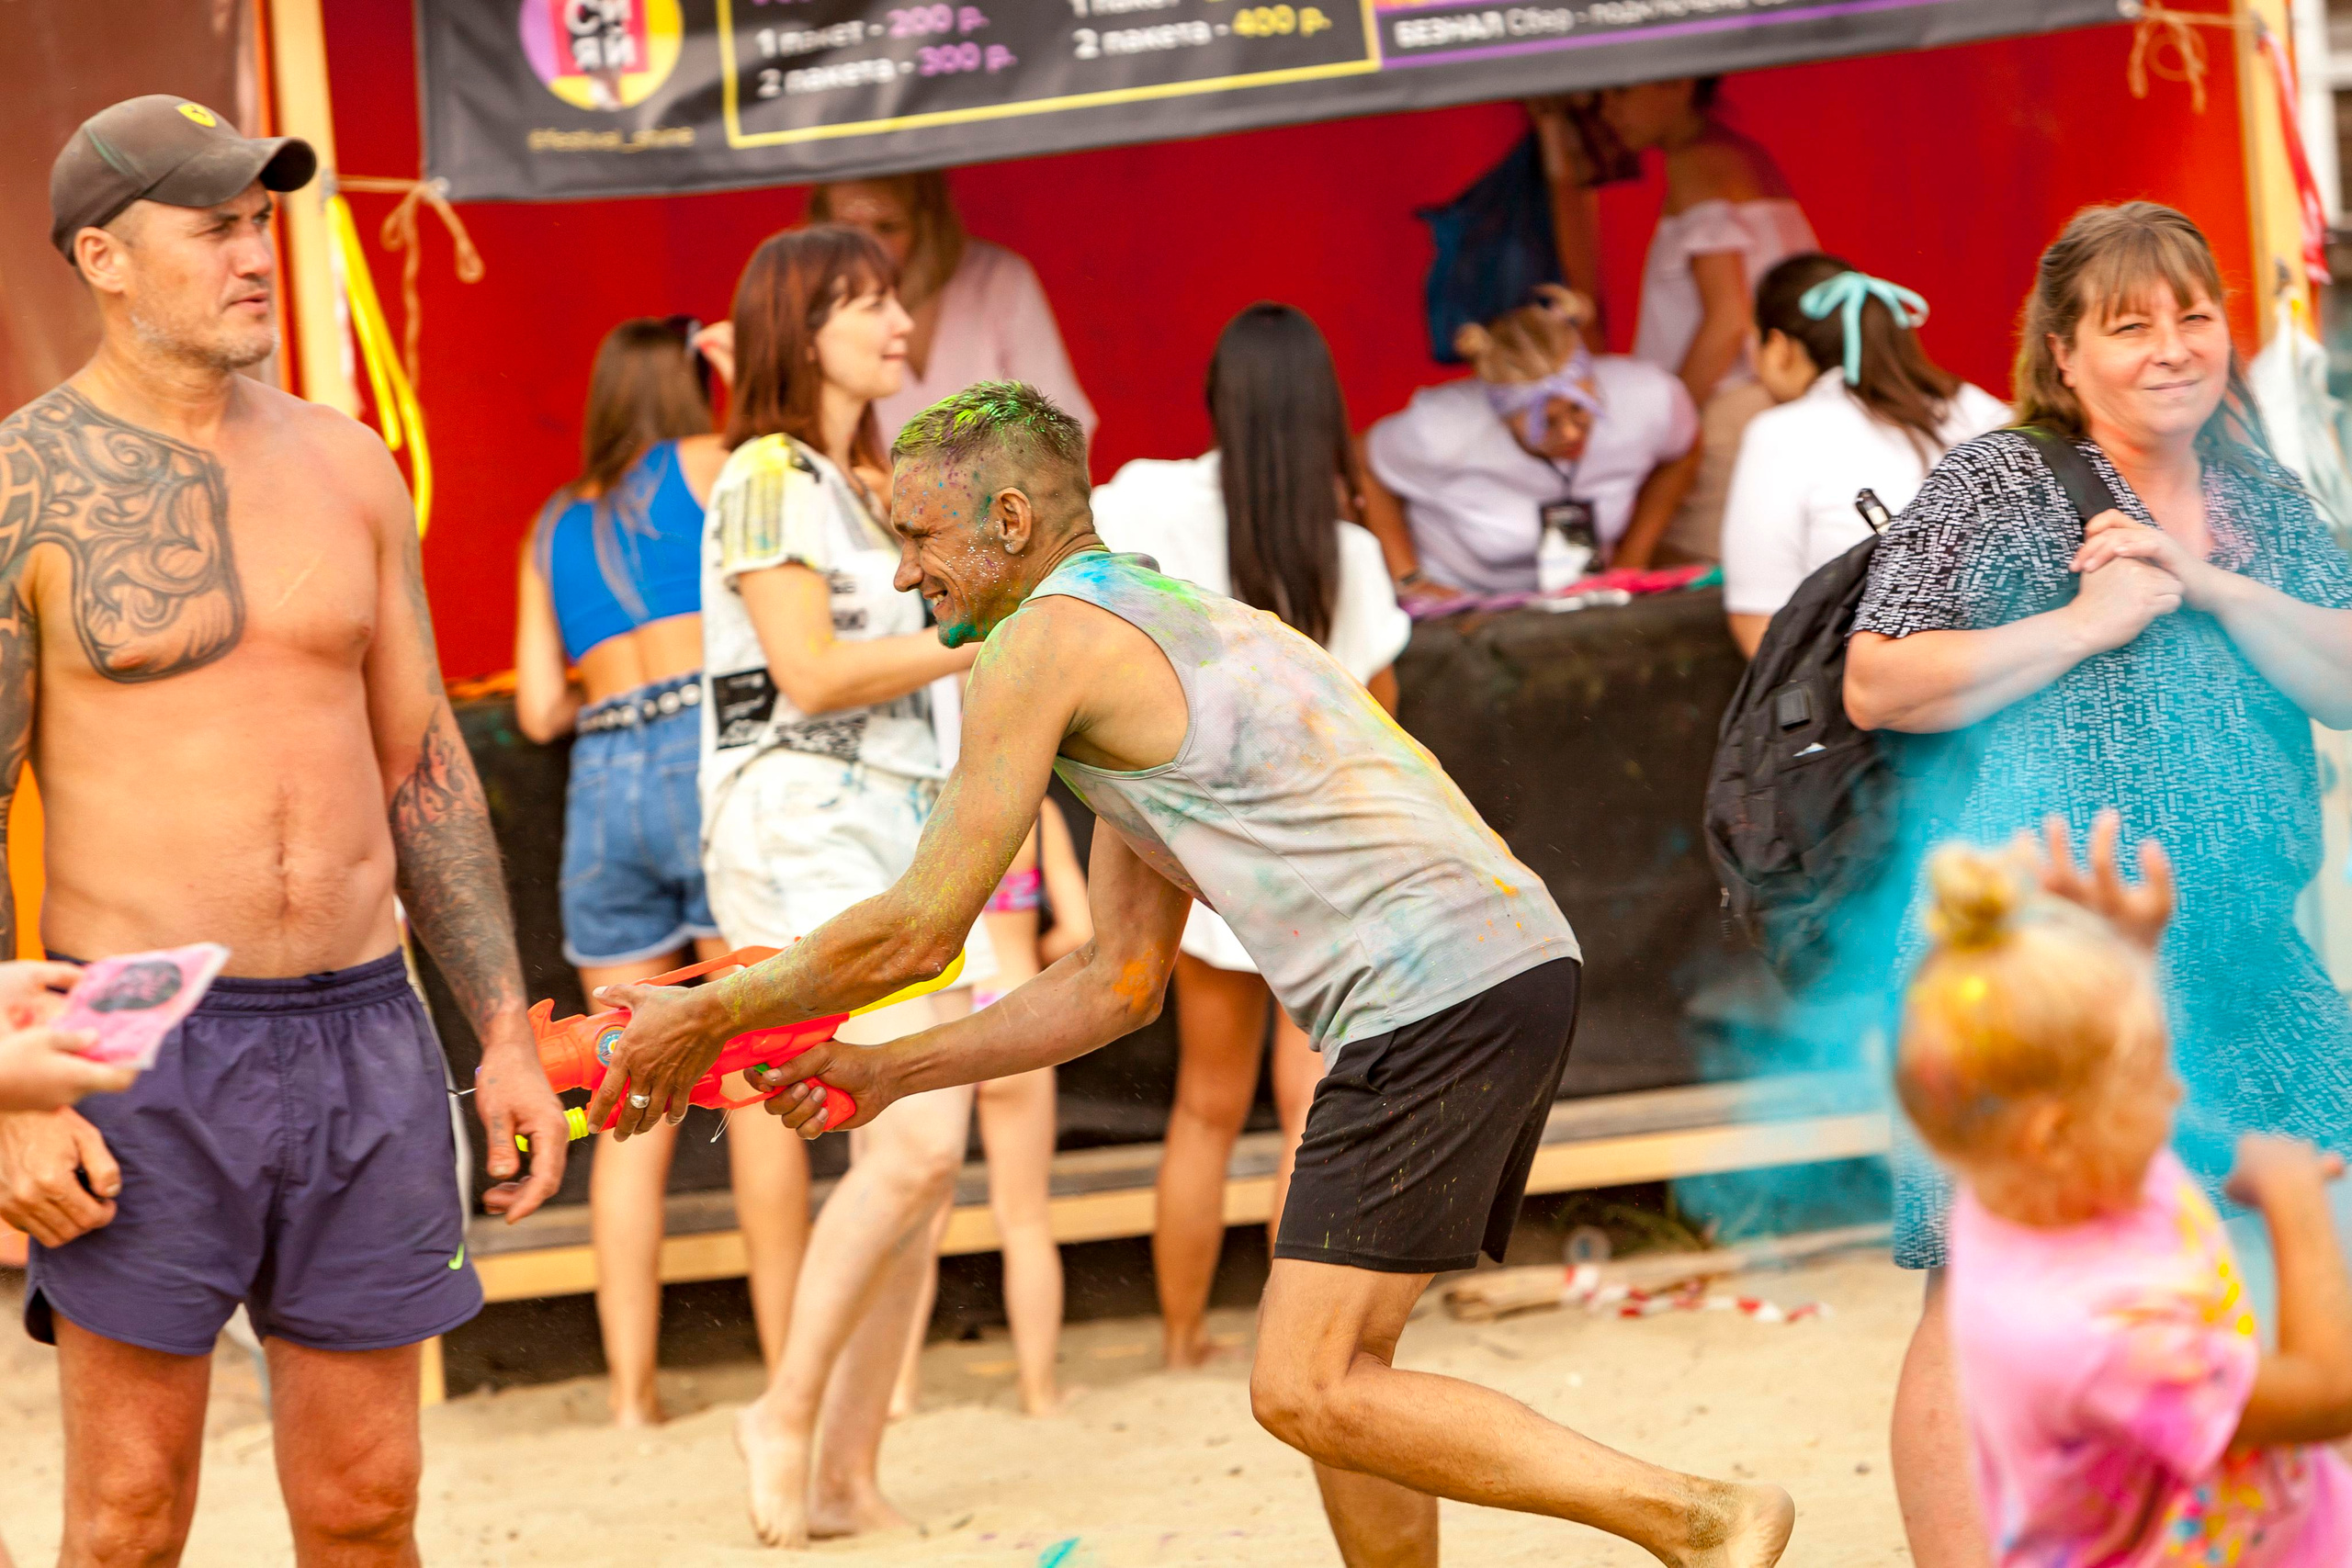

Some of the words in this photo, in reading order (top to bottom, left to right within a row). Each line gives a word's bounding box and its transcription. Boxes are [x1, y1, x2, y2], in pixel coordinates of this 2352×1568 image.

[756, 28, 777, 59] 1
[779, 20, 865, 57] пакет
[887, 3, 954, 39] 200
[1071, 28, 1101, 61] 2
[1102, 20, 1212, 56] пакета
[1231, 4, 1297, 39] 400
[1393, 10, 1506, 49] БЕЗНАЛ
[757, 67, 781, 99] 2
[784, 58, 897, 95] пакета
[917, 41, 982, 77] 300
